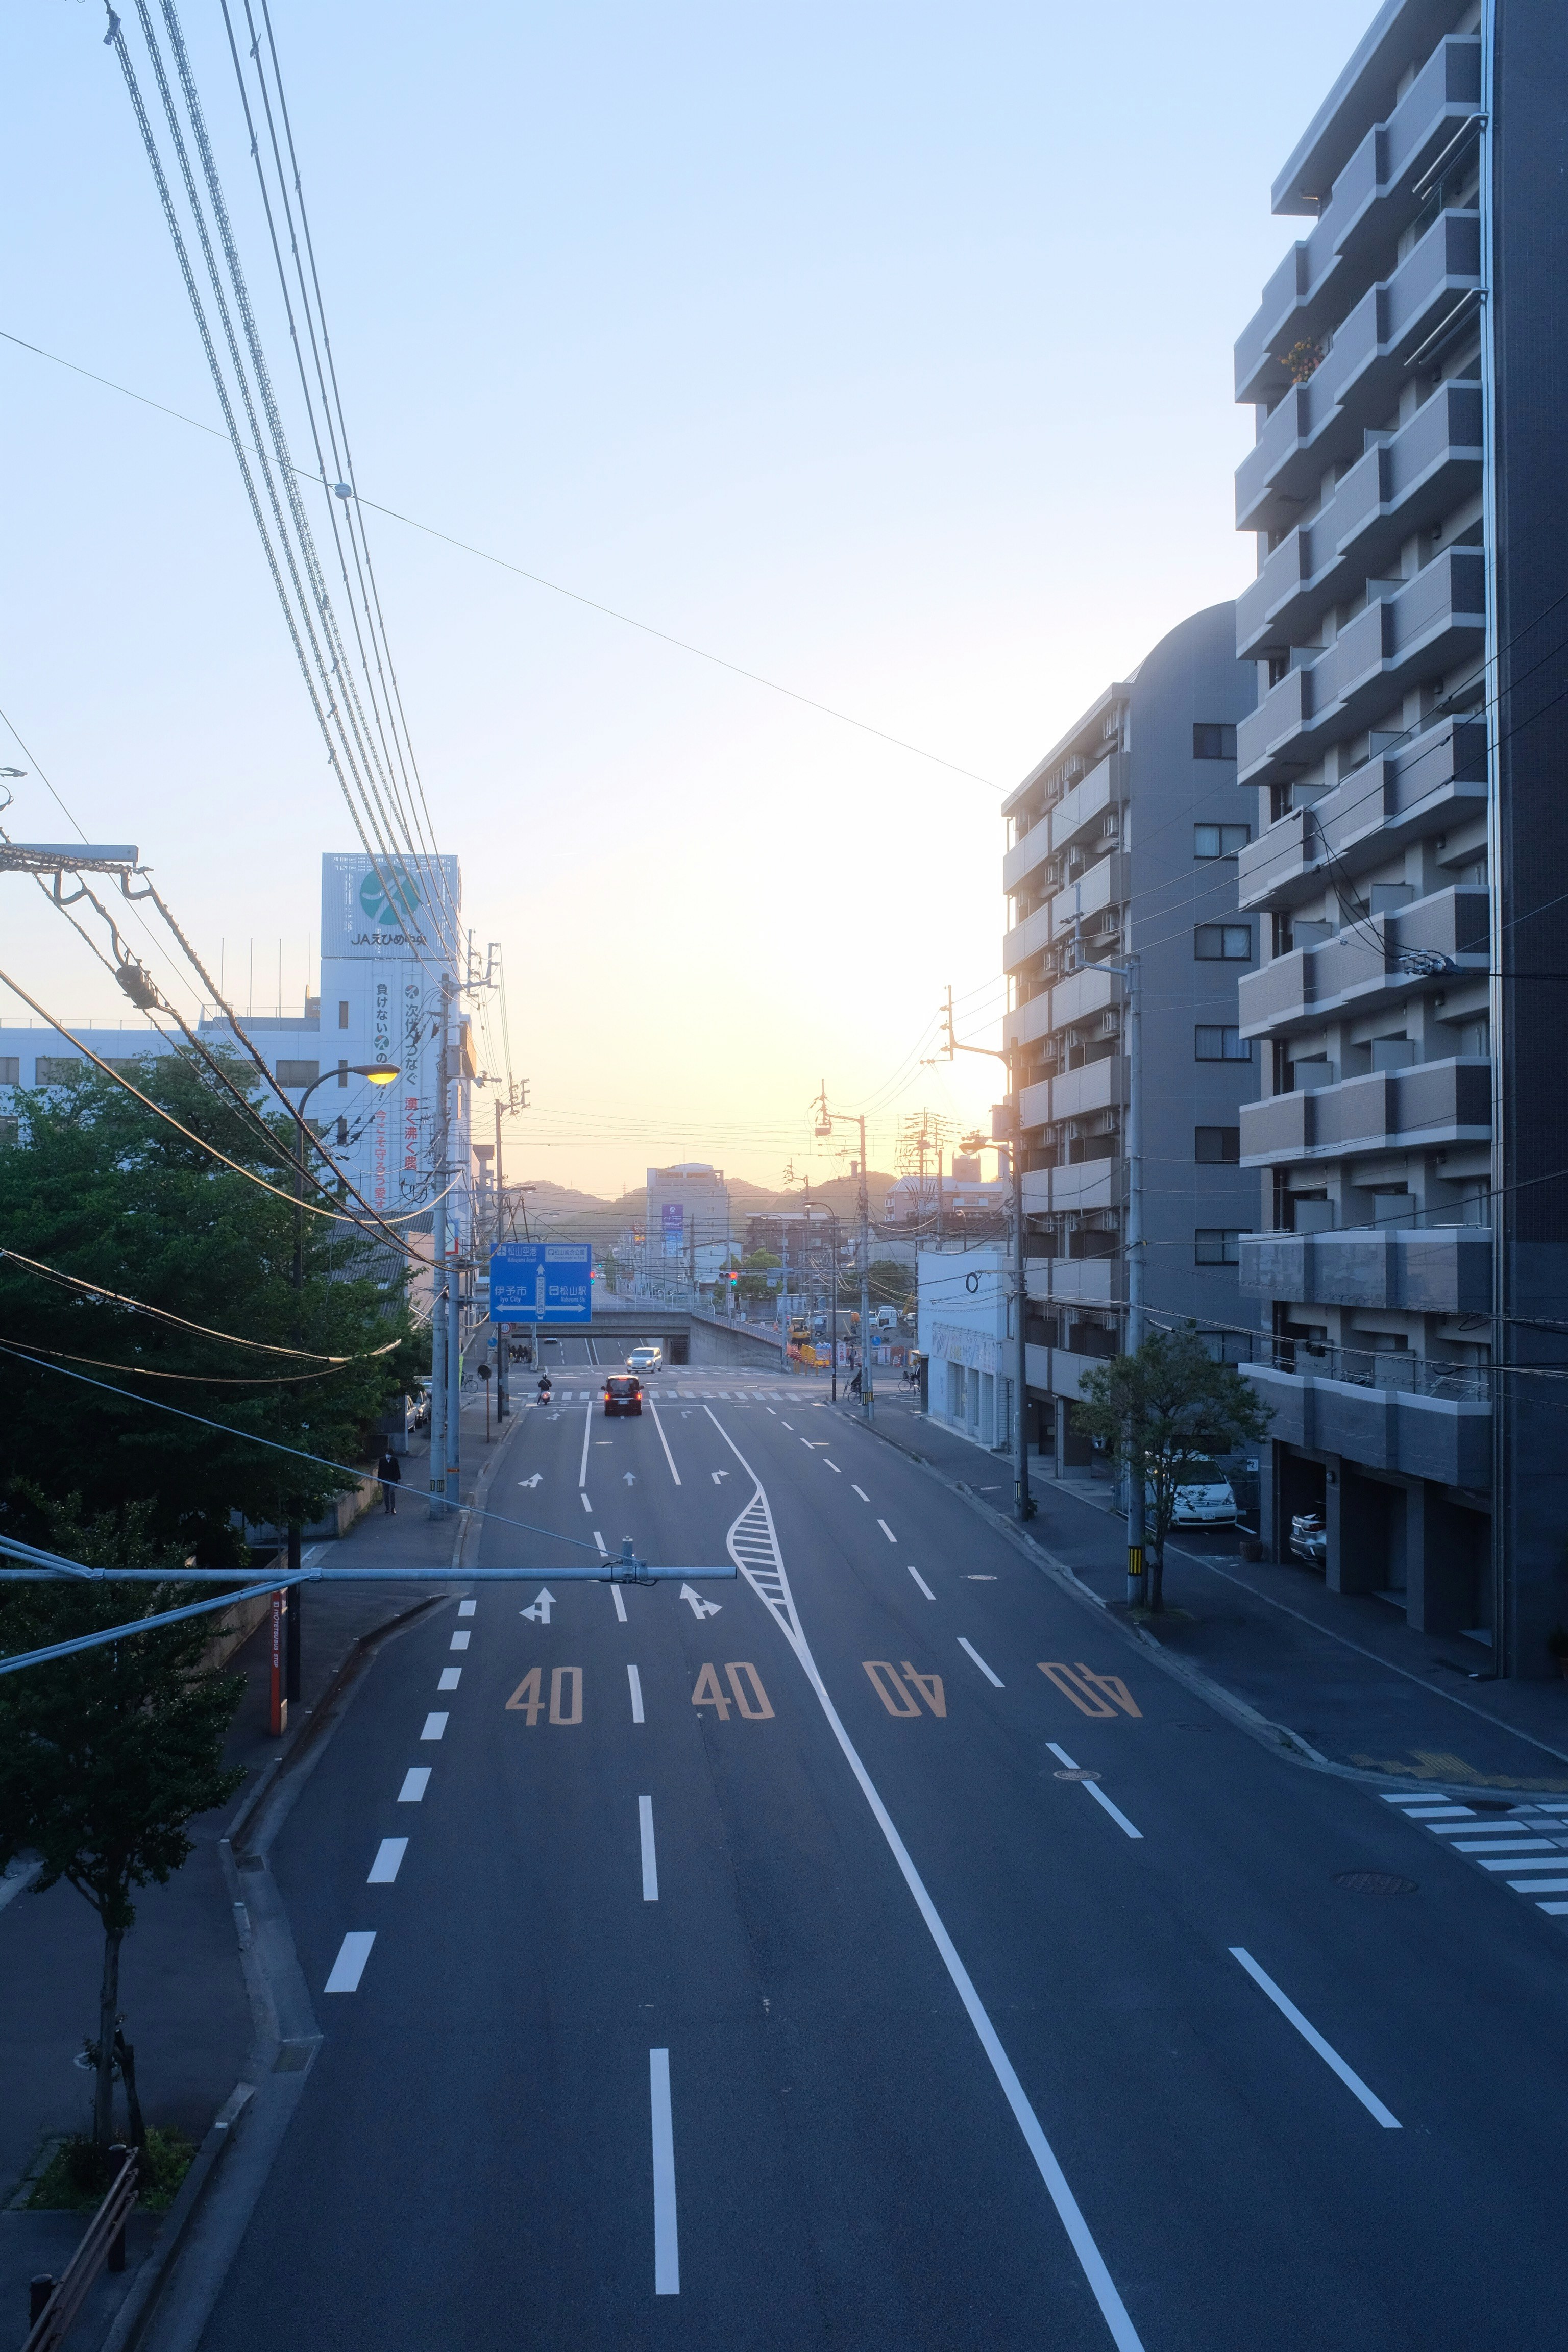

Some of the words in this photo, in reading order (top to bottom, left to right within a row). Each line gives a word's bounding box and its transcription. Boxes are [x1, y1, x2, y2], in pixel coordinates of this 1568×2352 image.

[351, 933, 427, 946] JAえひめ中央
[376, 983, 388, 1033] 負けない
[507, 1246, 537, 1256] 松山空港
[495, 1286, 527, 1296] 伊予市
[559, 1286, 587, 1296] 松山駅
[505, 1667, 583, 1726] 40
[692, 1662, 776, 1721] 40
[862, 1661, 947, 1718] 40
[1036, 1662, 1143, 1718] 40
